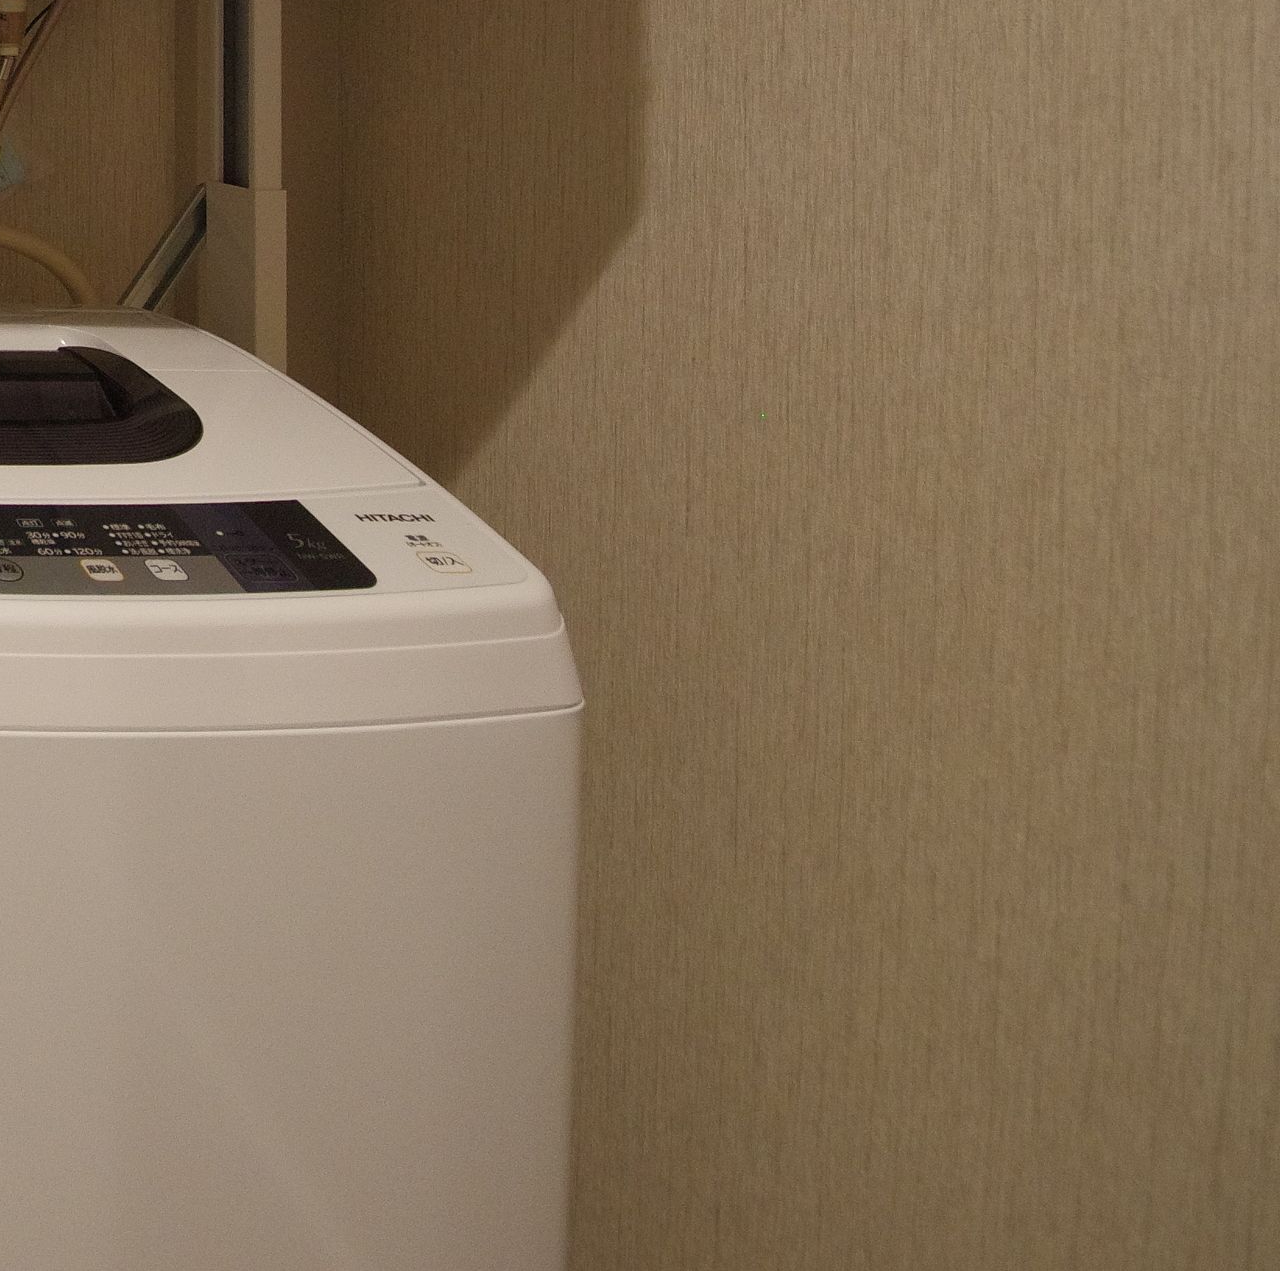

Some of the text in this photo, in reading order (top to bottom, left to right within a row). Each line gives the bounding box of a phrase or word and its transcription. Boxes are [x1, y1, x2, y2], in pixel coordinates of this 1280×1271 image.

[355, 513, 435, 523] HITACHI
[425, 556, 465, 566] 切/入
[149, 563, 184, 574] コース
